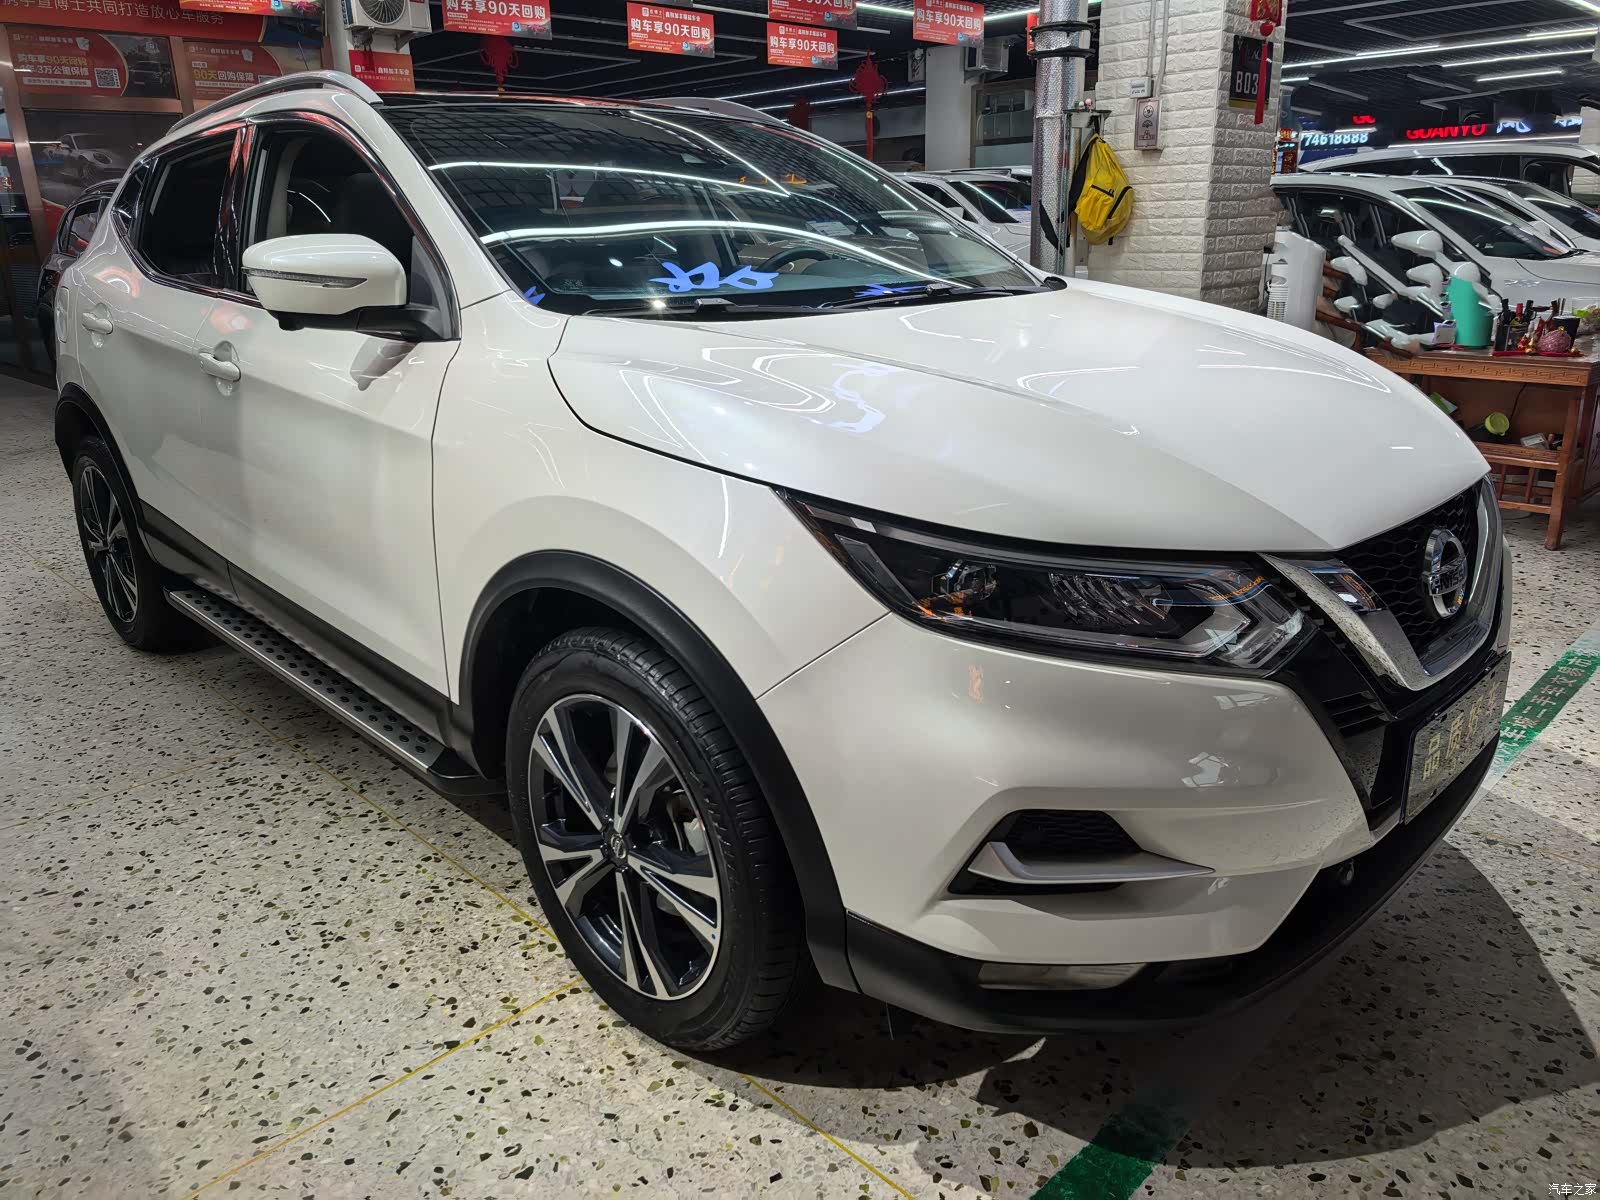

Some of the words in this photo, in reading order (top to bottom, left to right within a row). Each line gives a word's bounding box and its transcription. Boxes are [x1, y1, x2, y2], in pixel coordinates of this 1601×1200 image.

[446, 0, 546, 20] 购车享90天回购
[916, 8, 981, 31] 购车享90天回购
[631, 18, 710, 40] 购车享90天回购
[770, 35, 835, 54] 购车享90天回购
